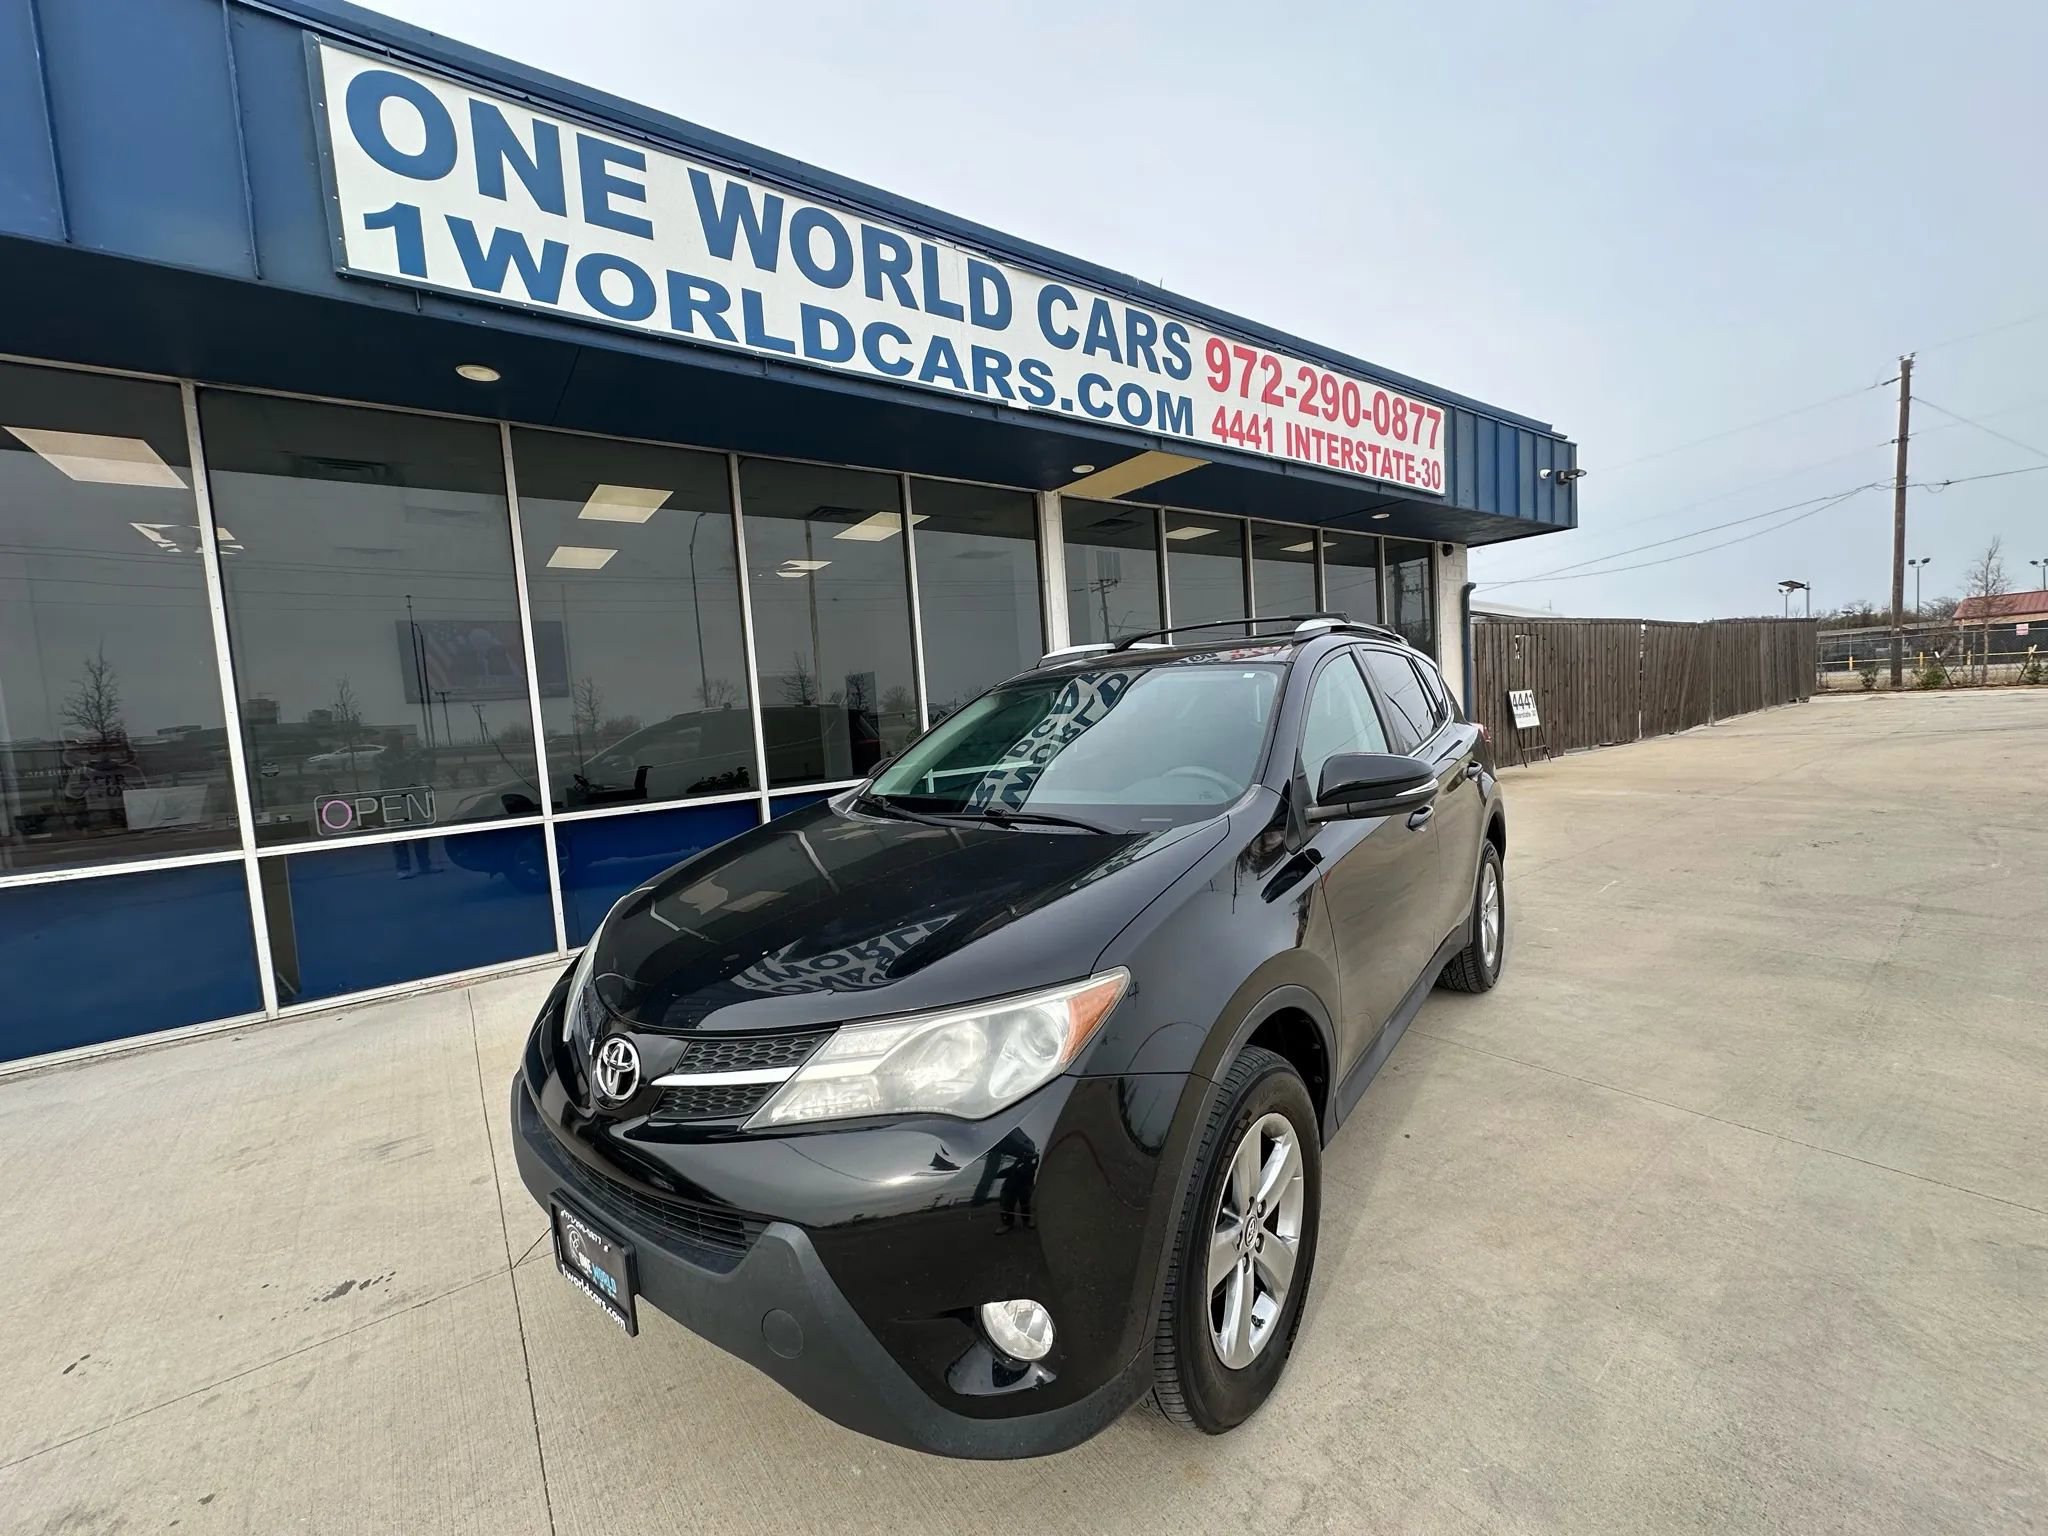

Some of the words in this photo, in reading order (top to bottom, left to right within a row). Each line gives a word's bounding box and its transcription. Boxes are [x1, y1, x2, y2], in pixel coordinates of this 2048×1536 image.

[346, 70, 653, 240] ONE
[687, 166, 1012, 331] WORLD
[1037, 283, 1191, 381] CARS
[363, 202, 1194, 438] 1WORLDCARS.COM
[1205, 337, 1441, 450] 972-290-0877
[1210, 405, 1273, 456] 4441
[1285, 421, 1441, 490] INTERSTATE-30
[1513, 693, 1535, 710] 4441
[322, 791, 430, 829] OPEN
[560, 1263, 627, 1331] 1worldcars.com
